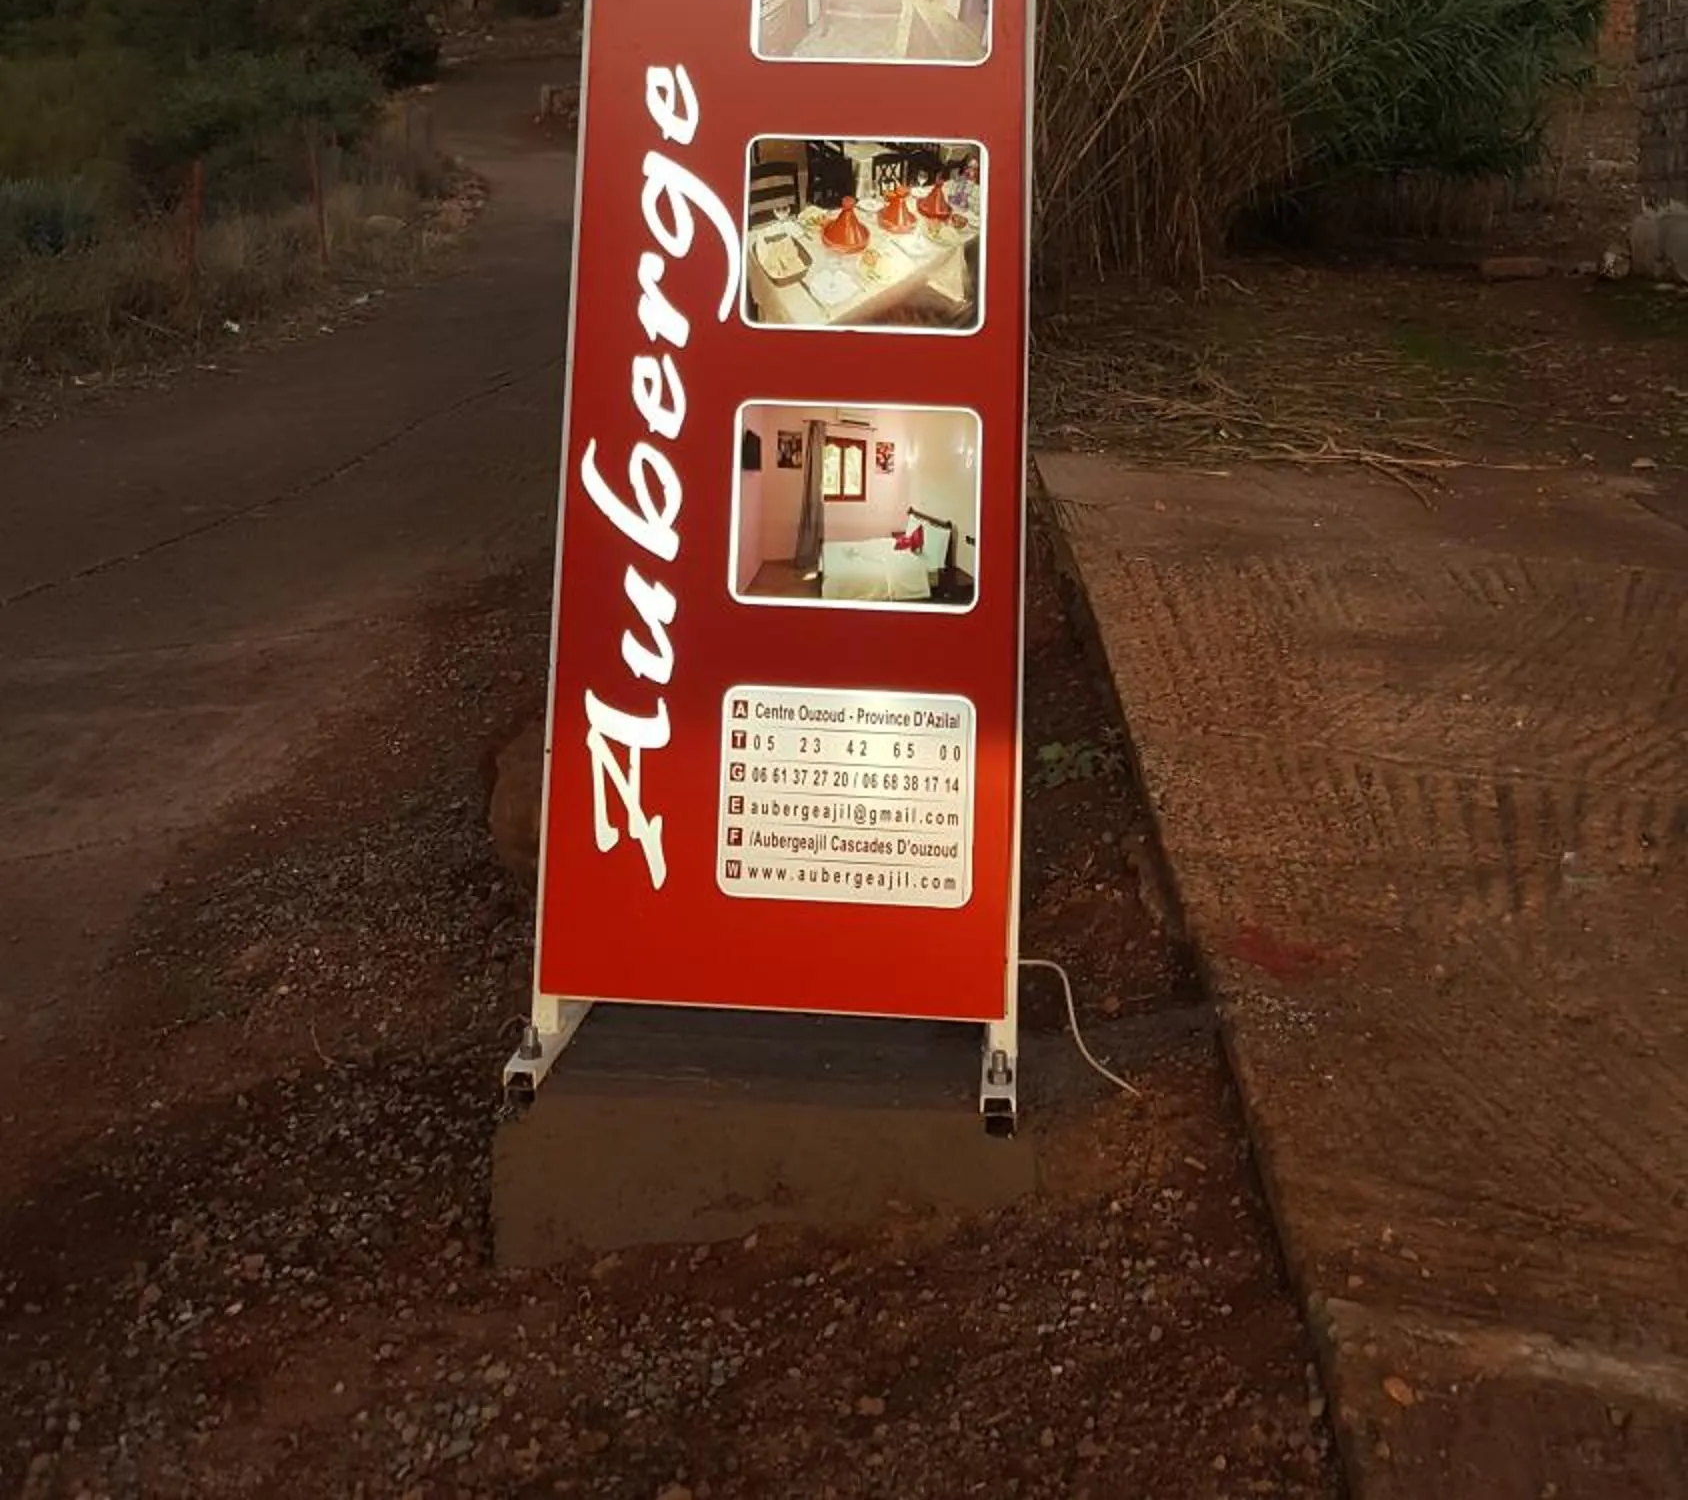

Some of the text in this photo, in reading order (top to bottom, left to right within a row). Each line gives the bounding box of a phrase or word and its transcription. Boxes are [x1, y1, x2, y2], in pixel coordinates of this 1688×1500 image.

[582, 63, 743, 891] Auberge
[734, 701, 747, 718] A
[755, 702, 795, 719] Centre
[798, 705, 845, 723] Ouzoud
[857, 708, 910, 727] Province
[913, 711, 960, 729] D'Azilal
[732, 731, 746, 749] T
[730, 764, 744, 781] G
[793, 768, 808, 786] 37
[813, 769, 828, 787] 27
[833, 771, 849, 788] 20
[903, 774, 919, 792] 38
[924, 776, 939, 793] 17
[945, 777, 959, 794] 14
[729, 796, 743, 814] E
[728, 828, 742, 846] F
[831, 835, 893, 855] Cascades
[897, 838, 958, 858] D'ouzoud
[726, 860, 957, 891] W www.aubergeajil.com
